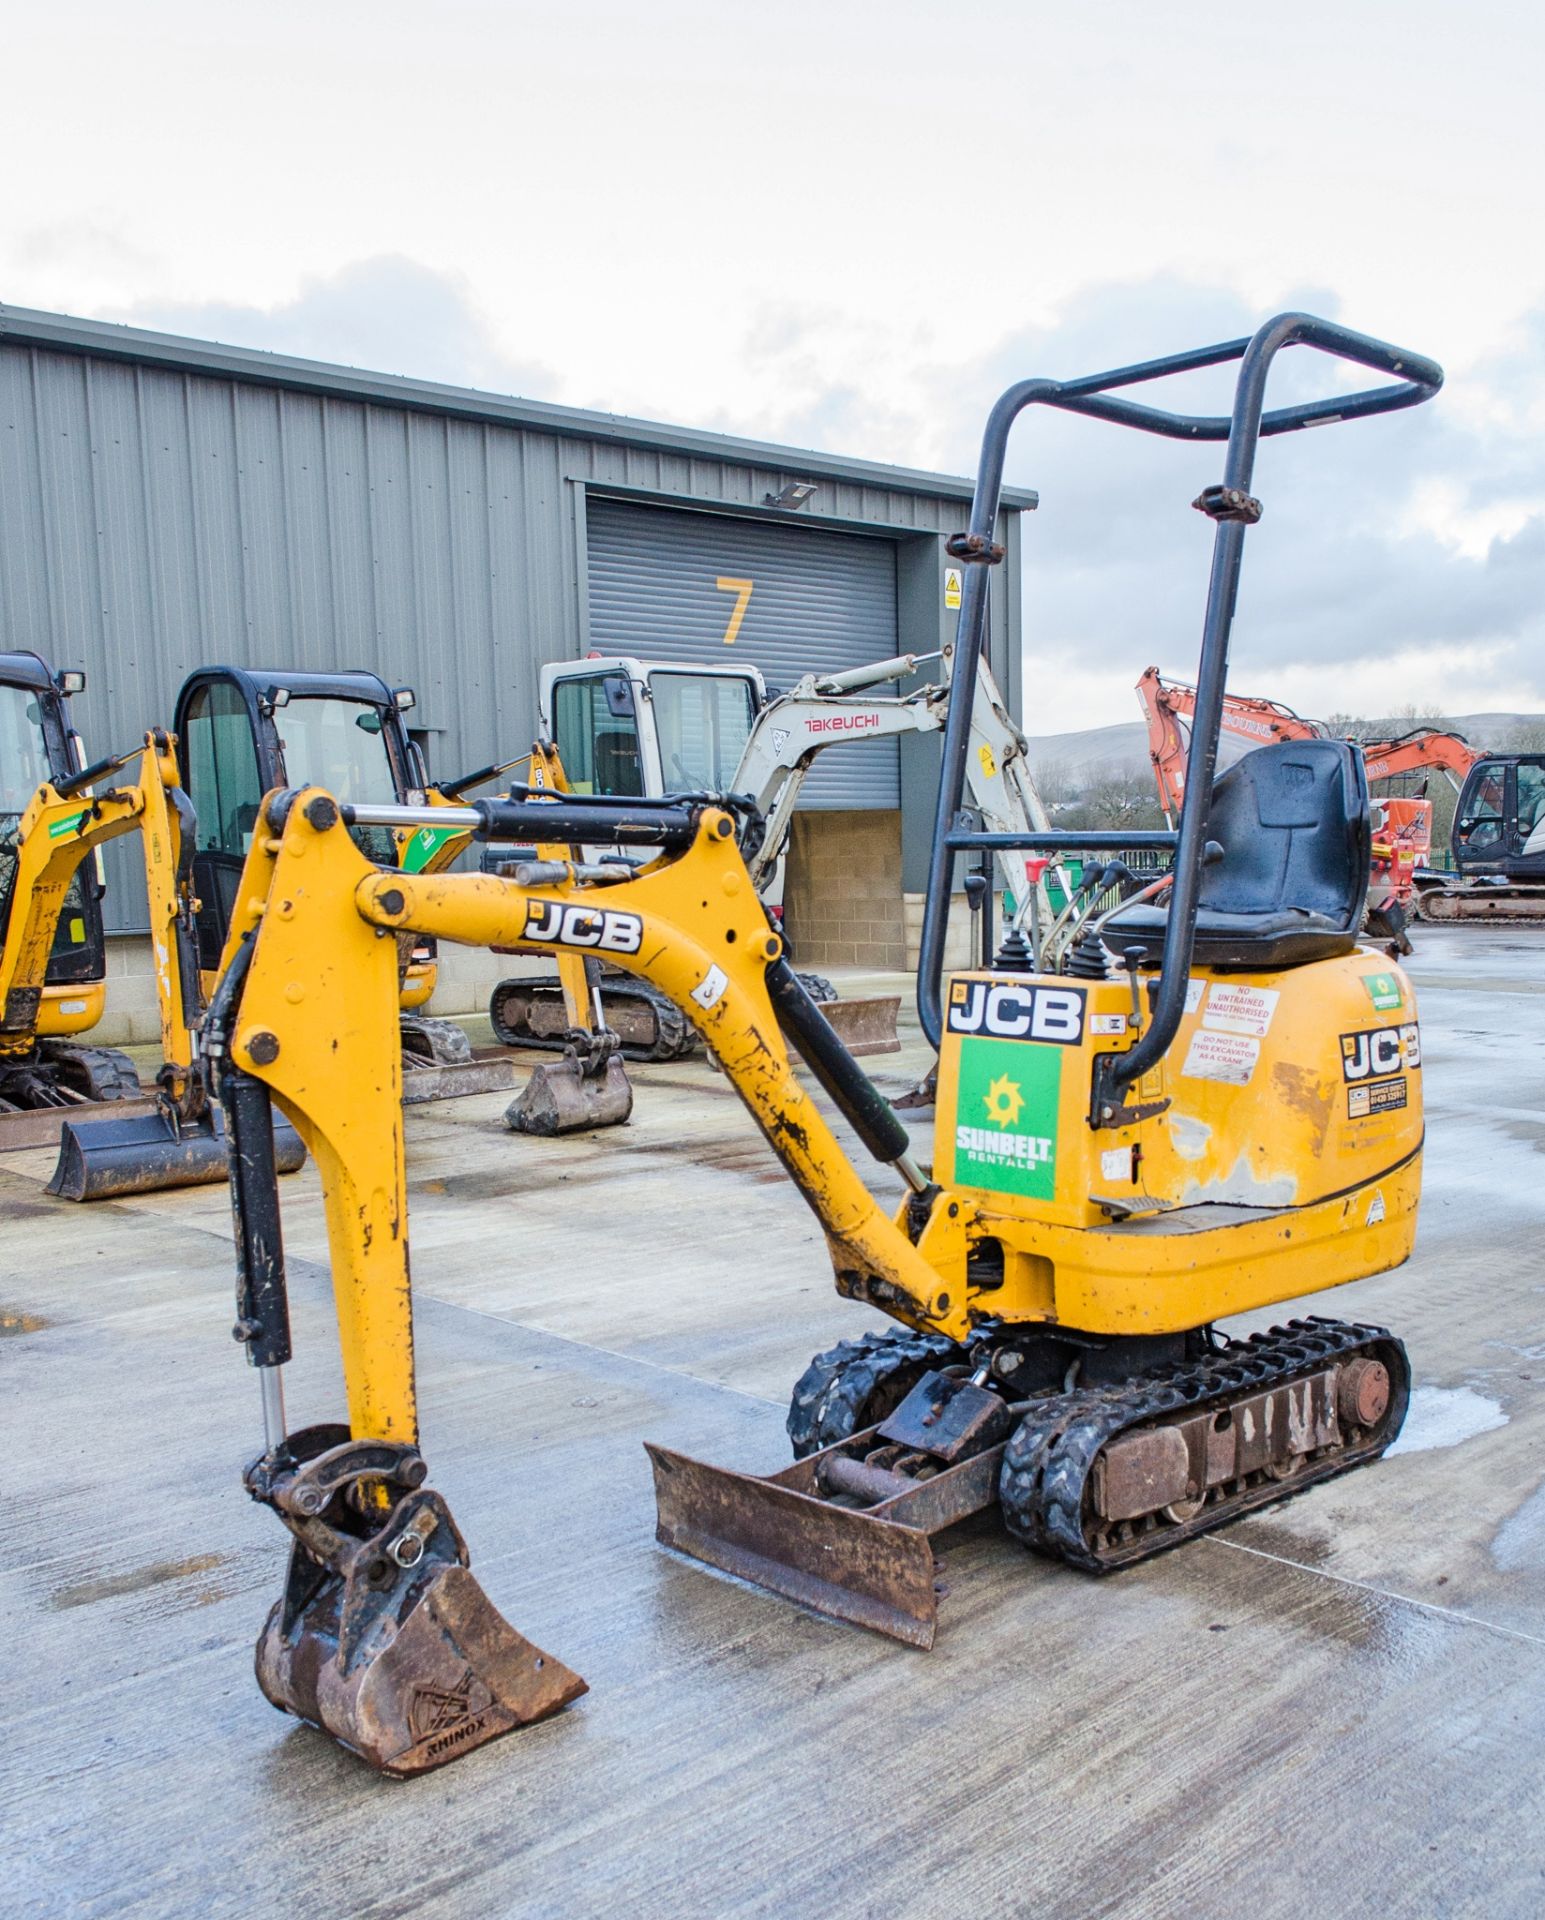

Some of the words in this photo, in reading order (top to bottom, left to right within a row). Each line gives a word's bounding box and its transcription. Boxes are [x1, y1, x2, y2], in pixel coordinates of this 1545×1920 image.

[717, 576, 753, 644] 7
[804, 714, 879, 733] TAKEUCHI
[525, 904, 642, 952] JCB
[1237, 986, 1250, 995] NO
[1207, 1002, 1269, 1018] UNAUTHORISED
[1217, 994, 1264, 1007] UNTRAINED
[950, 985, 1082, 1040] JCB
[1193, 1043, 1209, 1051] THIS
[1210, 1045, 1256, 1058] EXCAVATOR
[1203, 1035, 1214, 1043] DO
[1216, 1037, 1232, 1046] NOT
[1235, 1040, 1250, 1048] USE
[1217, 1055, 1243, 1065] CRANE
[1345, 1025, 1420, 1078] JCB
[956, 1126, 1052, 1162] SUNBELT
[968, 1151, 1036, 1170] RENTALS
[427, 1716, 486, 1757] RHINOX
